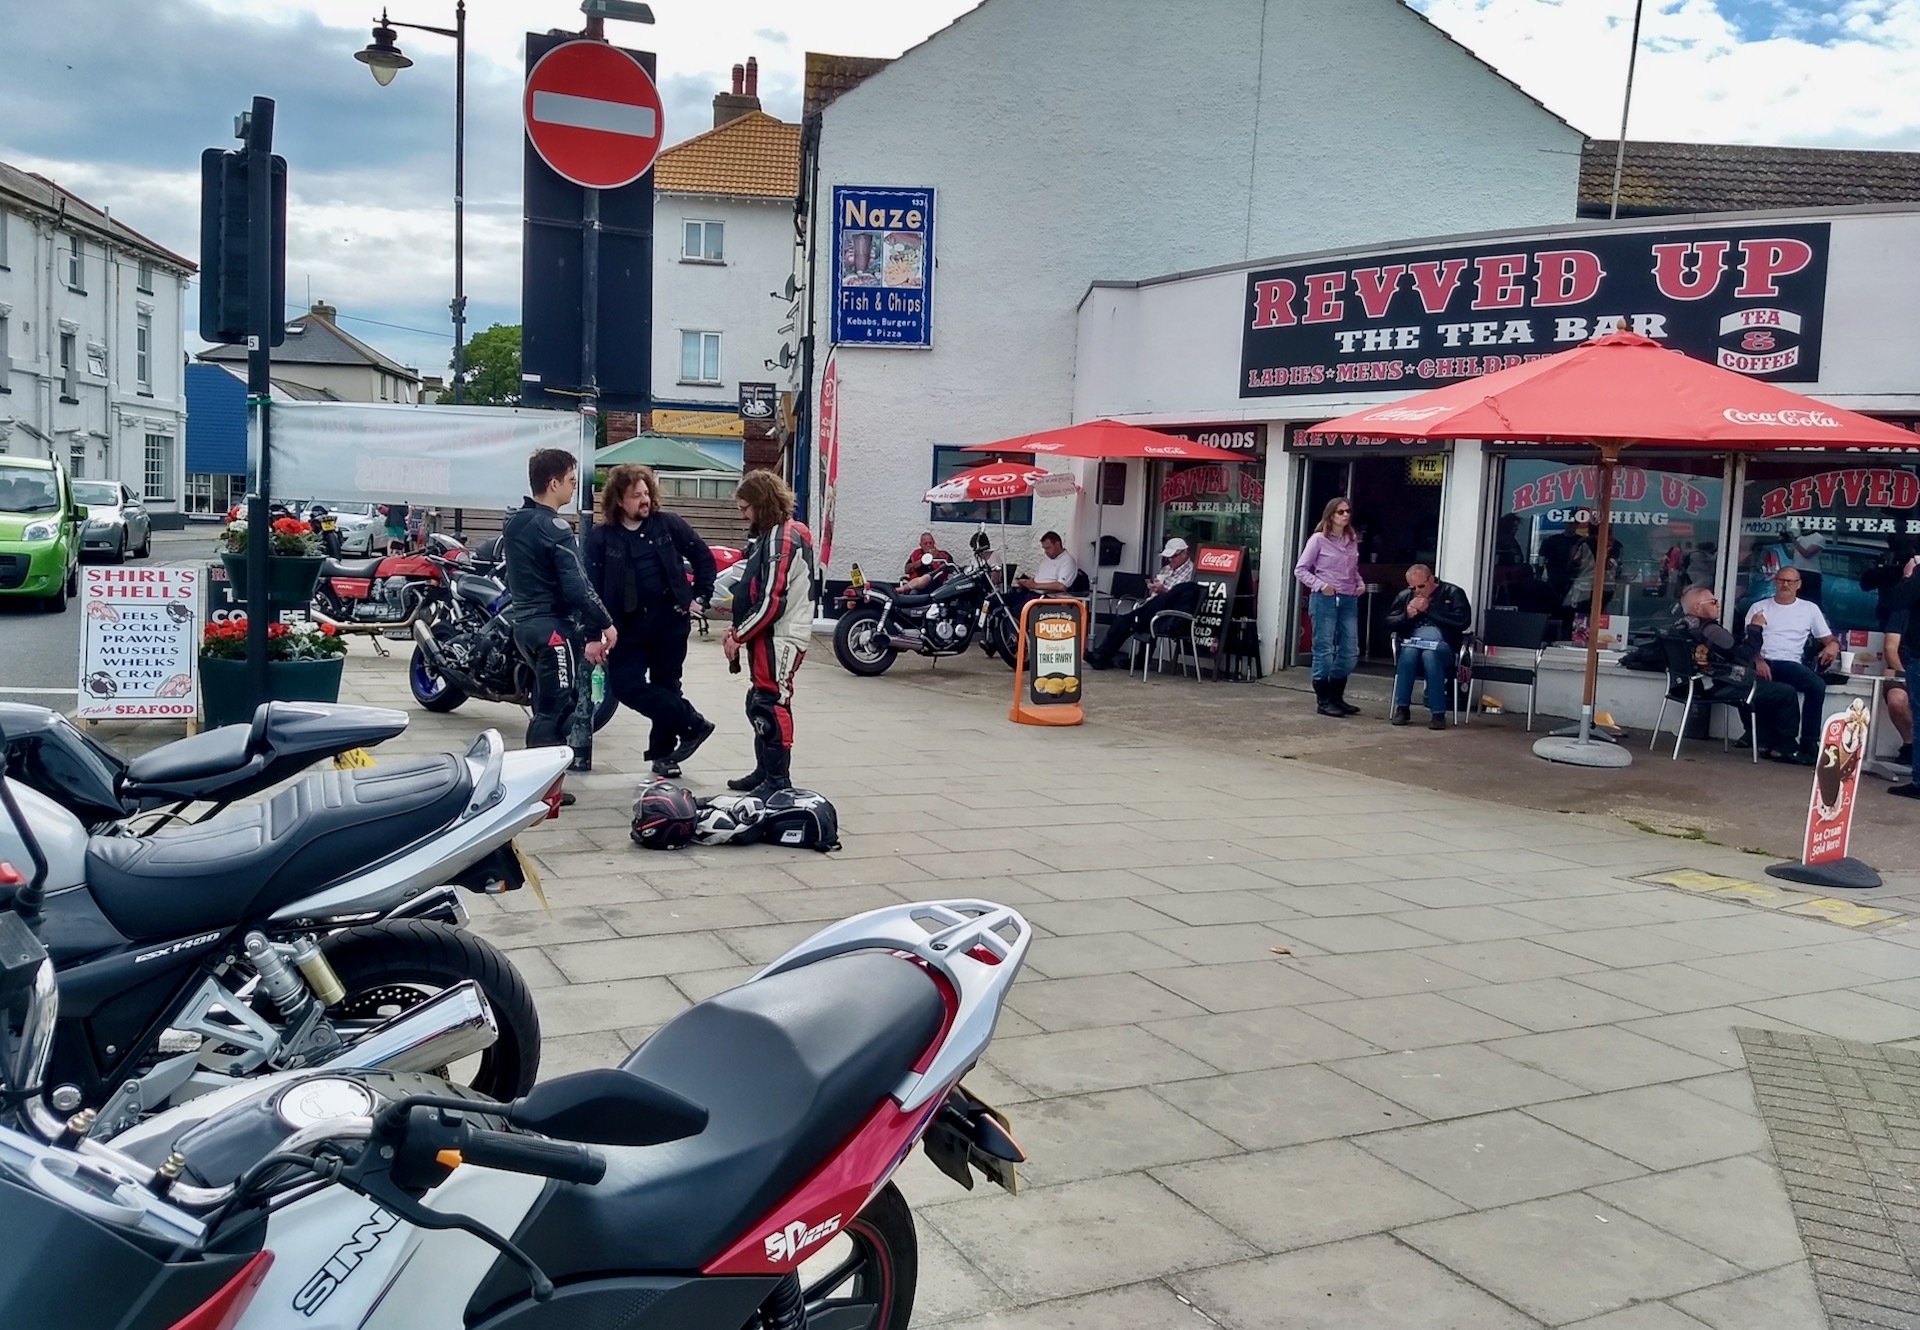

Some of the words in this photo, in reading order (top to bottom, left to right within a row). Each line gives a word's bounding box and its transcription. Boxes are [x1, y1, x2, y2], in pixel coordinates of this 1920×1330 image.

[845, 199, 922, 229] Naze
[1252, 250, 1606, 330] REVVED
[1651, 238, 1812, 301] UP
[842, 291, 869, 311] Fish
[875, 292, 882, 311] &
[887, 292, 921, 315] Chips
[881, 318, 917, 327] Burgers
[1740, 310, 1781, 326] TEA
[866, 329, 873, 337] &
[877, 329, 902, 337] Pizza
[1334, 326, 1421, 354] THE
[1437, 319, 1534, 347] TEA
[1553, 313, 1668, 342] BAR
[249, 338, 255, 348] 5
[1741, 331, 1775, 350] &
[1722, 349, 1796, 371] COFFEE
[1248, 364, 1325, 388] LADIES
[1335, 360, 1405, 382] MENS
[1723, 408, 1840, 427] Coca-Cola
[1197, 431, 1255, 449] GOODS
[1417, 460, 1437, 471] THE
[979, 485, 1016, 496] WALL'S
[1160, 465, 1231, 504] REVVED
[1238, 471, 1264, 505] UP
[1660, 474, 1708, 516] UP
[1760, 469, 1920, 520] REVVED
[1170, 502, 1194, 512] THE
[1197, 502, 1220, 512] TEA
[1225, 502, 1251, 513] BAR
[1786, 515, 1837, 532] THE
[1845, 517, 1897, 533] TEA
[1201, 552, 1235, 567] Coca-Cola
[87, 569, 195, 583] SHIRL'S
[89, 585, 192, 598] SHELLS
[122, 612, 159, 620] EELS
[99, 623, 181, 632] COCKLES
[1039, 623, 1072, 635] PUKKA
[103, 635, 177, 643] PRAWNS
[99, 646, 179, 655] MUSSELS
[102, 658, 175, 667] WHELKS
[1039, 653, 1054, 664] TAKE
[1054, 653, 1073, 664] AWAY
[115, 670, 163, 678] CRAB
[122, 681, 155, 690] ETC
[81, 704, 112, 716] Fresh
[115, 705, 194, 715] SEAFOOD
[1813, 831, 1823, 843] Ice
[1824, 825, 1842, 839] Cream
[1812, 844, 1826, 857] Sold
[1826, 837, 1841, 851] Here!
